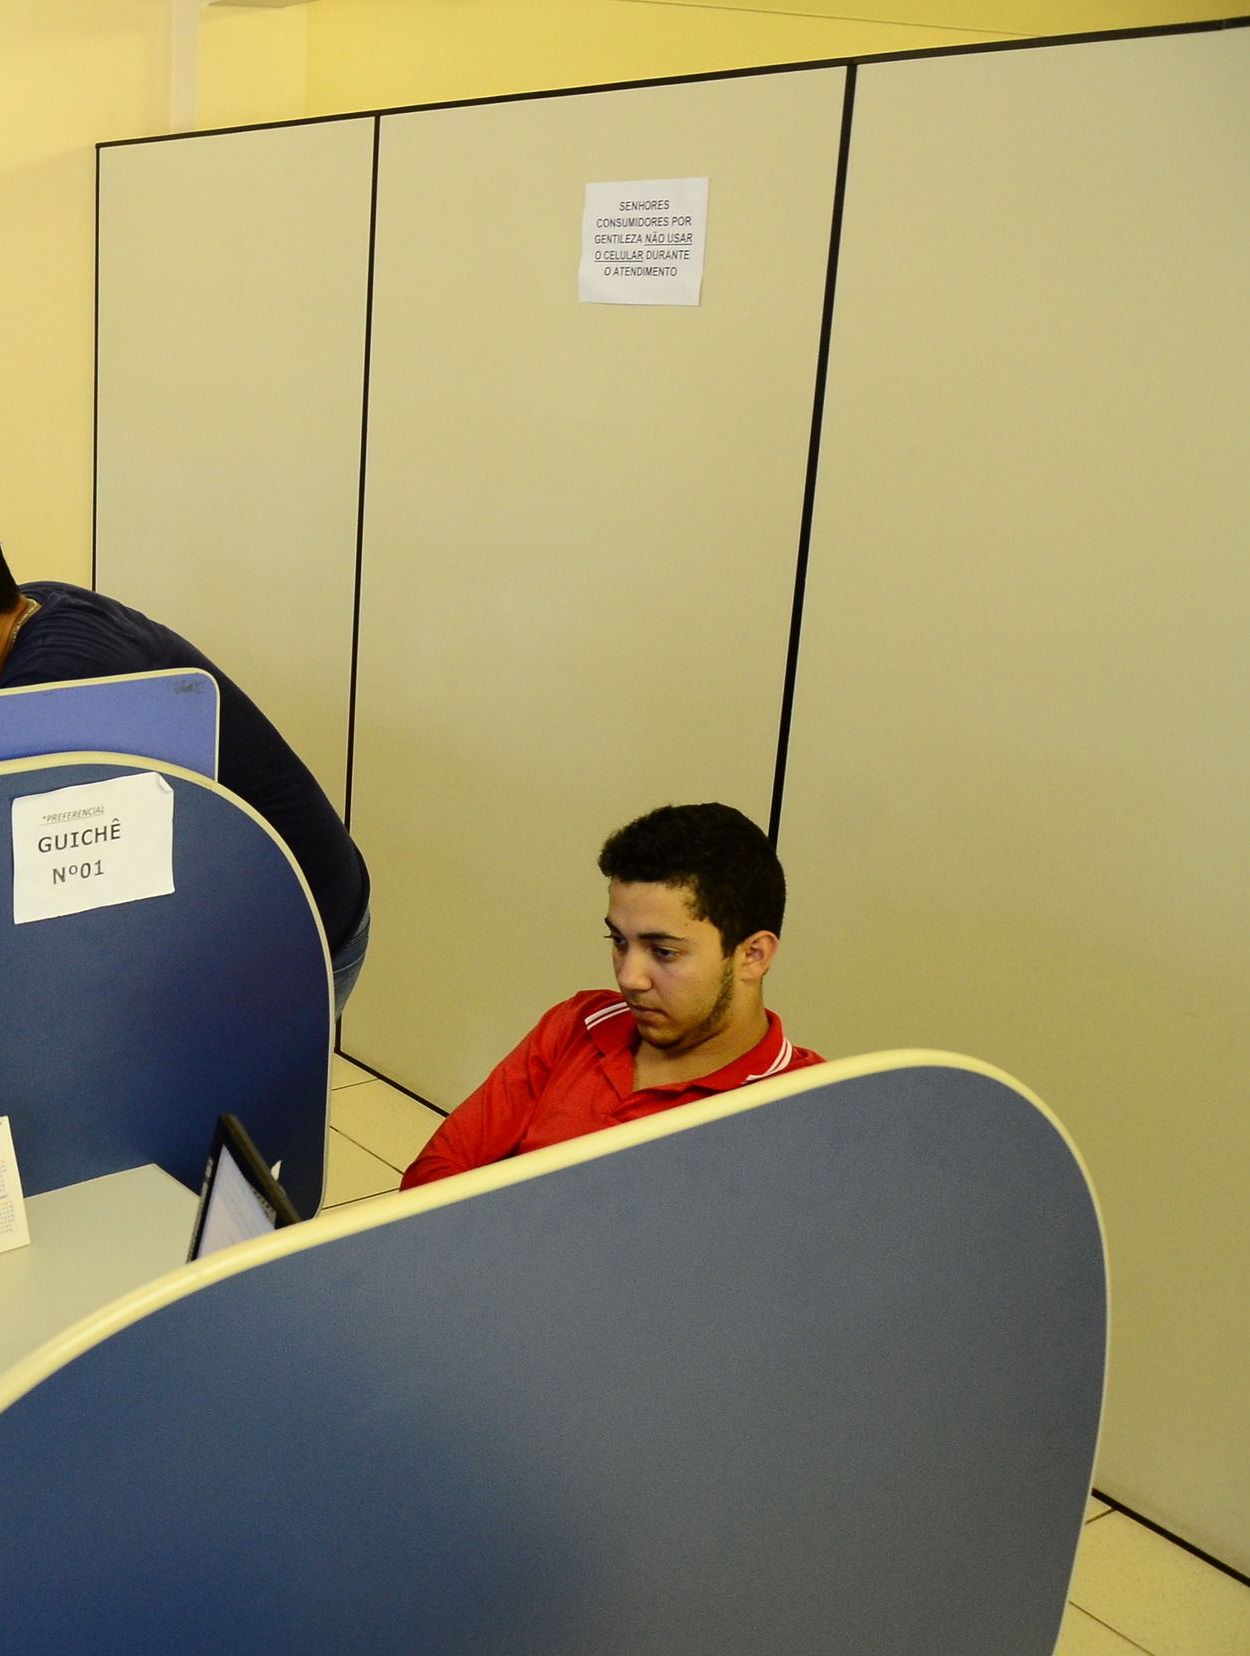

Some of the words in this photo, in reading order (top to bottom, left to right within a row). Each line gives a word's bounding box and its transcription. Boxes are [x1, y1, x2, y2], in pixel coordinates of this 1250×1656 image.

[619, 200, 670, 211] SENHORES
[597, 217, 669, 227] CONSUMIDORES
[672, 216, 692, 226] POR
[595, 234, 642, 244] GENTILEZA
[645, 232, 664, 243] NÃO
[668, 233, 693, 243] USAR
[595, 251, 601, 260] O
[604, 251, 643, 260] CELULAR
[646, 250, 689, 260] DURANTE
[604, 267, 611, 276] O
[613, 267, 677, 276] ATENDIMENTO
[38, 818, 121, 853] GUICHÊ
[53, 860, 104, 884] Nº01
